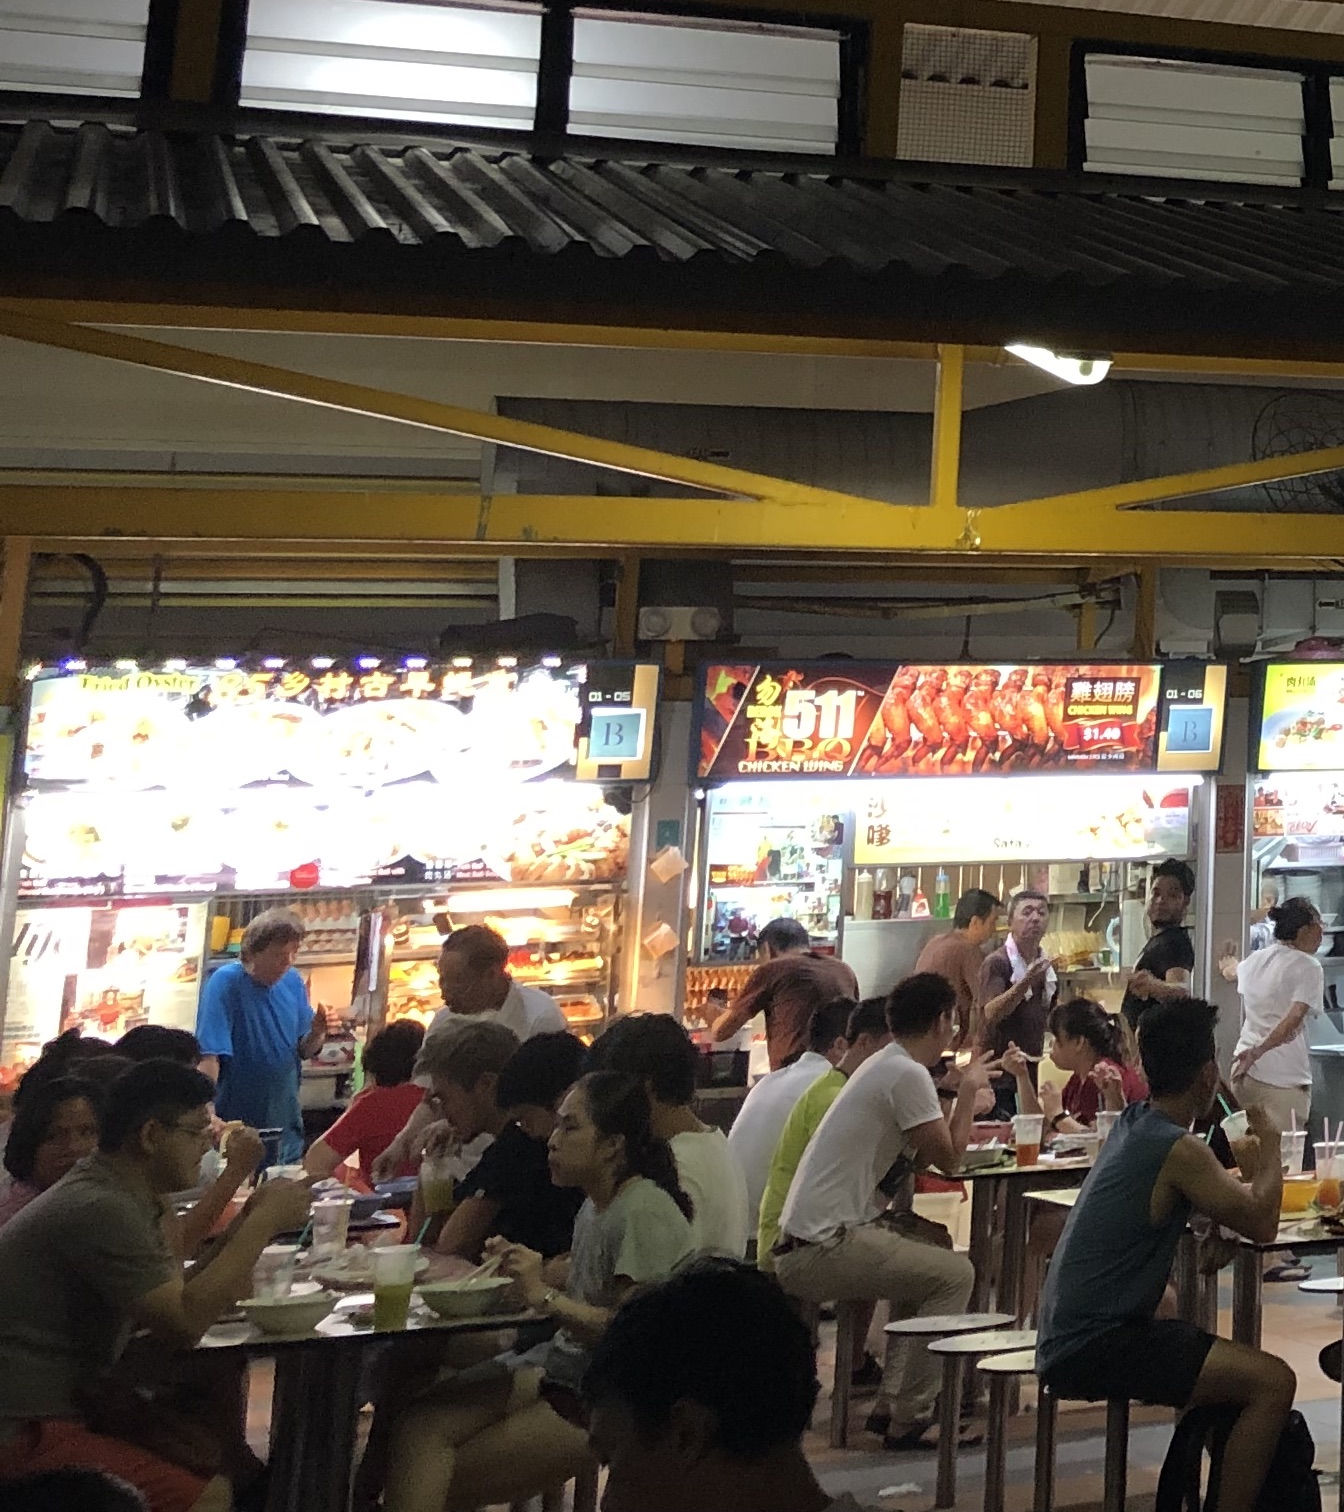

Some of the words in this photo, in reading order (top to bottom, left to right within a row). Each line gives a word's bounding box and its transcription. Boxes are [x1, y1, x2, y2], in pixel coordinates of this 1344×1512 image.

[80, 673, 129, 692] Fried
[136, 671, 199, 694] Oyster
[783, 689, 857, 740] 511
[603, 721, 625, 747] B
[1083, 727, 1121, 741] $1.40
[744, 737, 852, 762] BBQ
[738, 760, 800, 773] CHICKEN
[803, 760, 844, 773] WING
